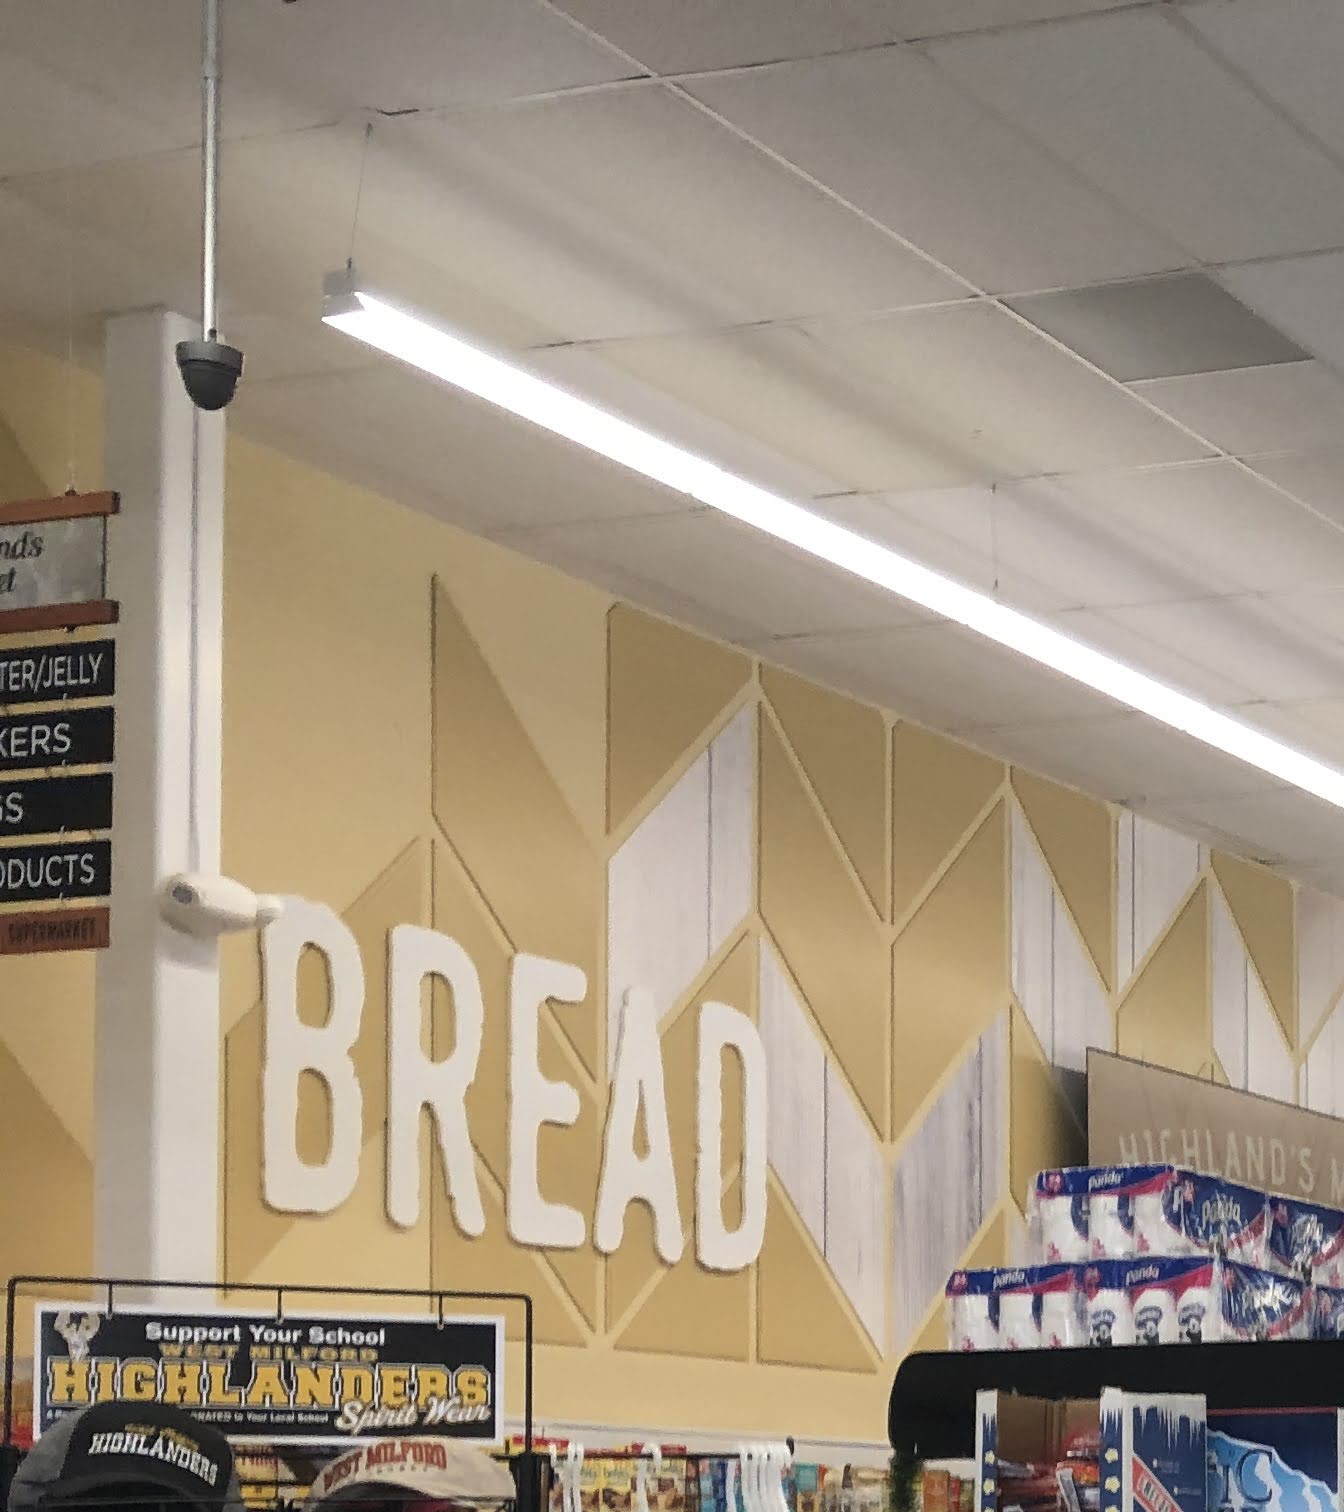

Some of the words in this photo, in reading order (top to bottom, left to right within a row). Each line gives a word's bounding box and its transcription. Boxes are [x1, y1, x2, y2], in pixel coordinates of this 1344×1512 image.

[0, 853, 96, 889] DUCTS
[259, 893, 770, 1273] BREAD
[145, 1321, 241, 1345] Support
[249, 1324, 301, 1344] Your
[309, 1325, 386, 1346] School
[47, 1355, 491, 1413] HIGHLANDERS
[335, 1396, 418, 1435] Spirit
[421, 1395, 492, 1425] Wear
[88, 1431, 219, 1487] HIGHLANDERS
[365, 1440, 448, 1470] MILFORD
